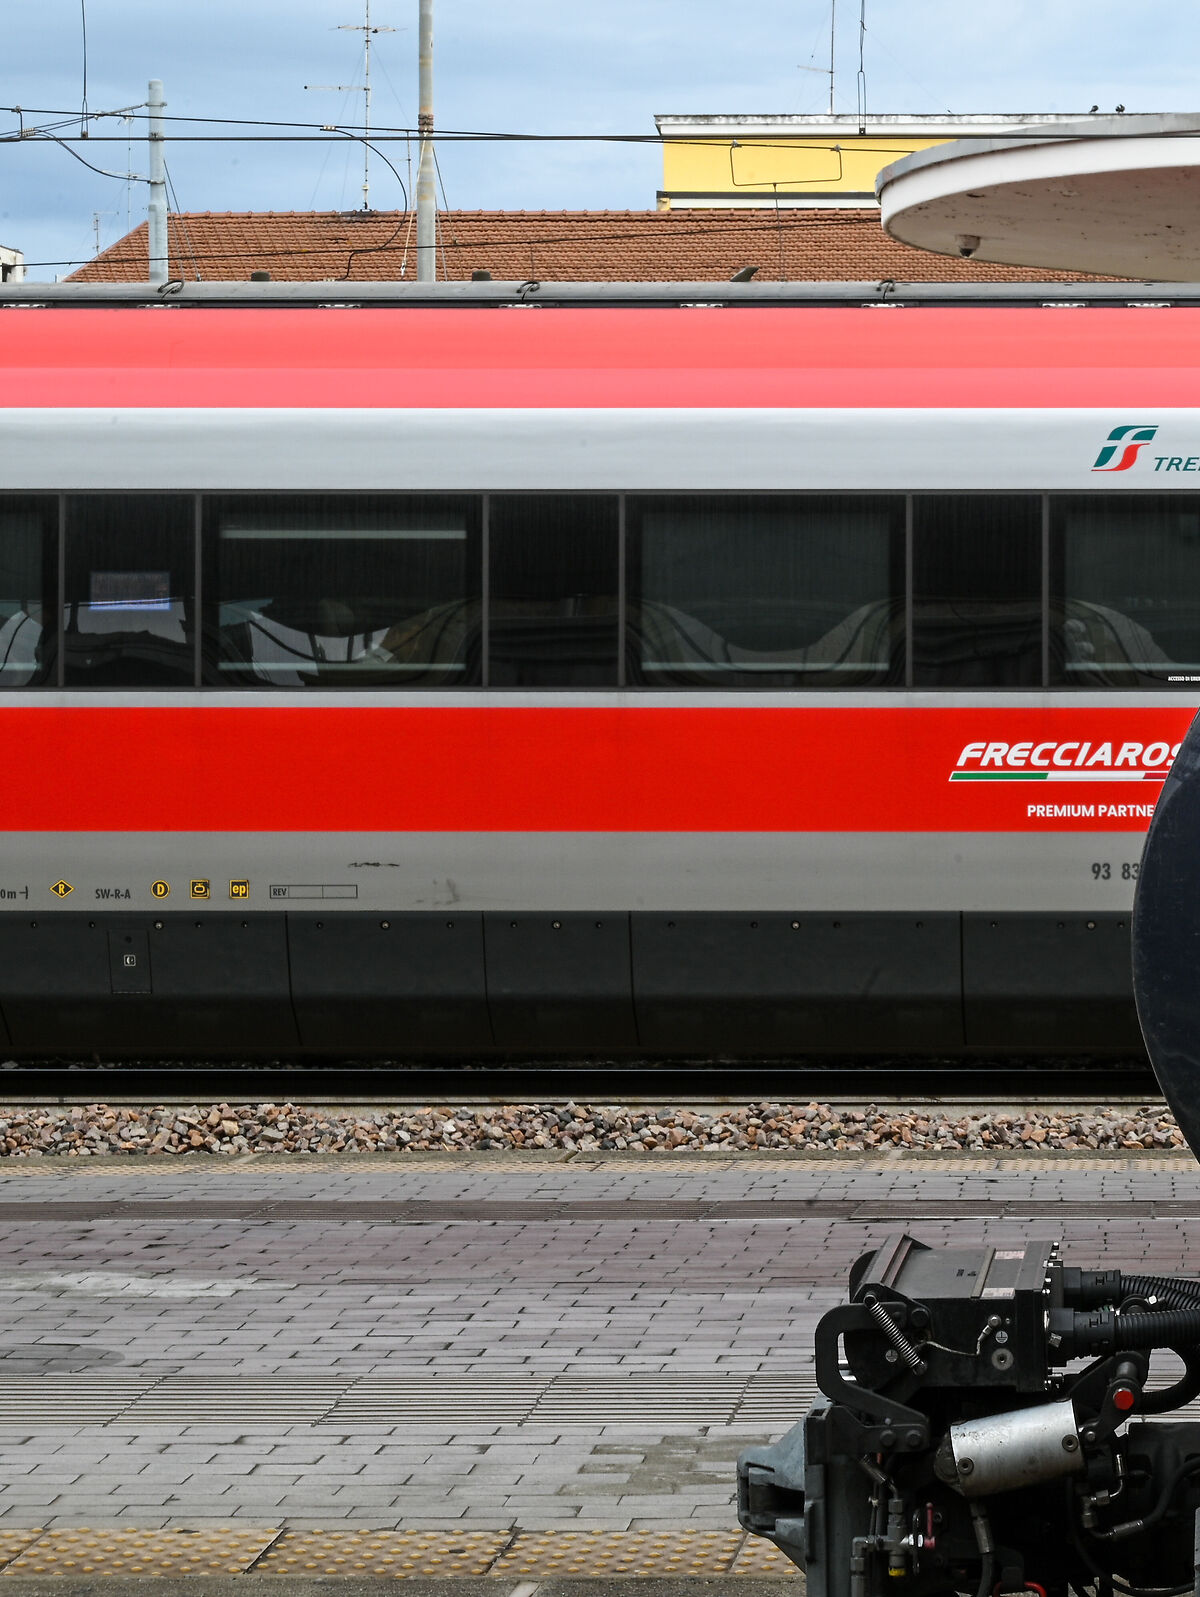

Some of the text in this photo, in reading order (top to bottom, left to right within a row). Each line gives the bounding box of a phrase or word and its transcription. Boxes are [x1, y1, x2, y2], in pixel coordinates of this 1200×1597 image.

[1027, 805, 1155, 817] PREMIUM PARTNE
[1092, 862, 1140, 880] 93 83
[95, 888, 131, 900] SW-R-A
[232, 885, 246, 897] ep
[272, 888, 287, 896] REV
